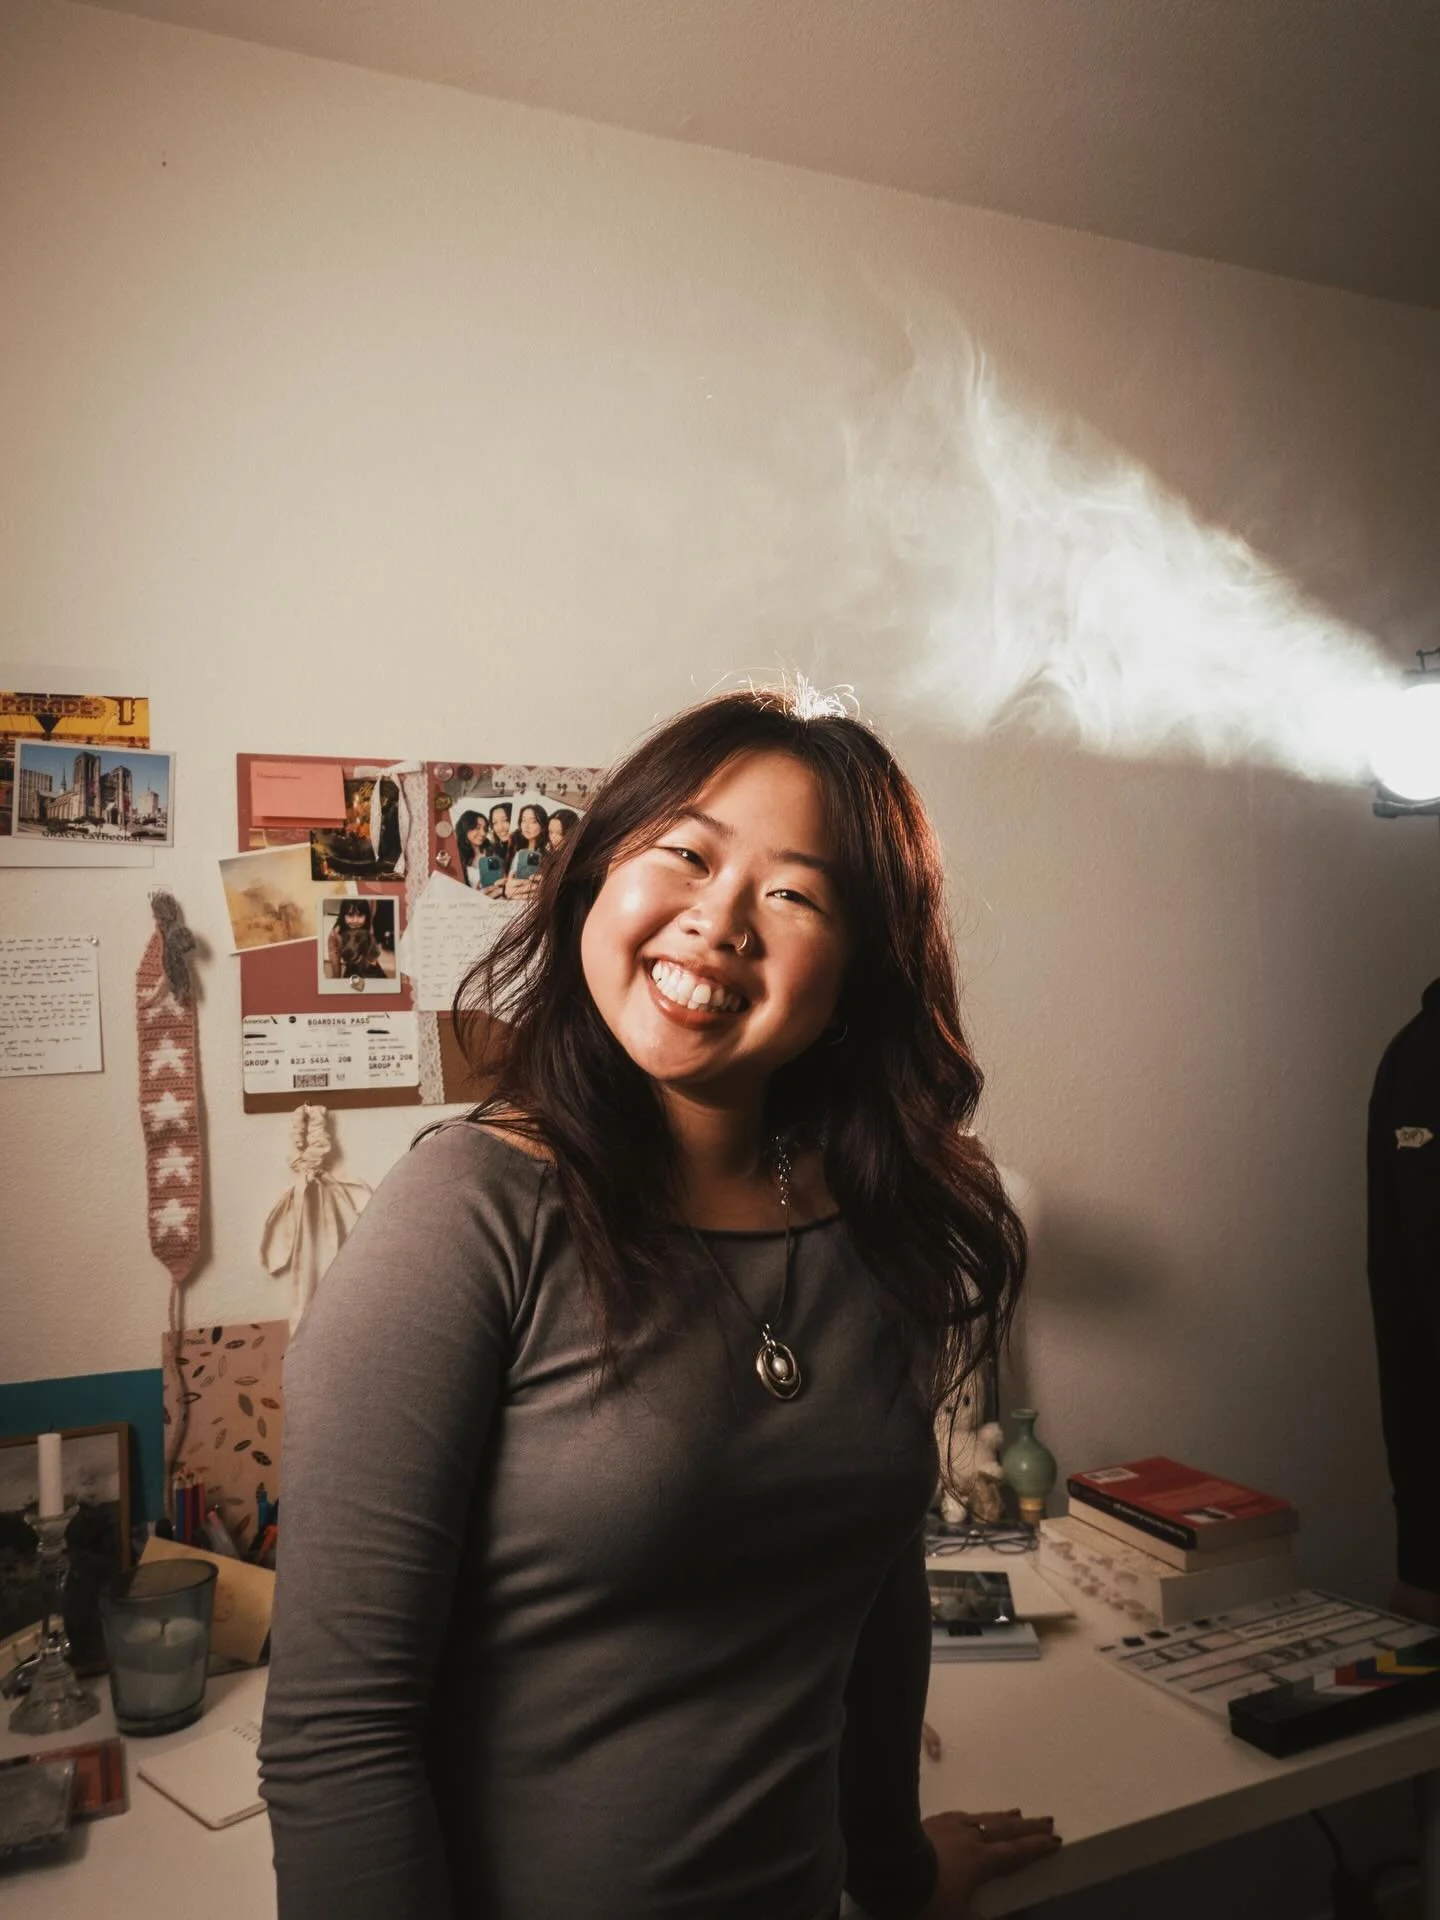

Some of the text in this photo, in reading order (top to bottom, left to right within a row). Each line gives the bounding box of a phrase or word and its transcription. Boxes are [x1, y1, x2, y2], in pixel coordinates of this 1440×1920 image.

[1, 695, 94, 716] PARADE
[307, 1017, 370, 1026] BOARDING PASS
[244, 1059, 269, 1067] GROUP
